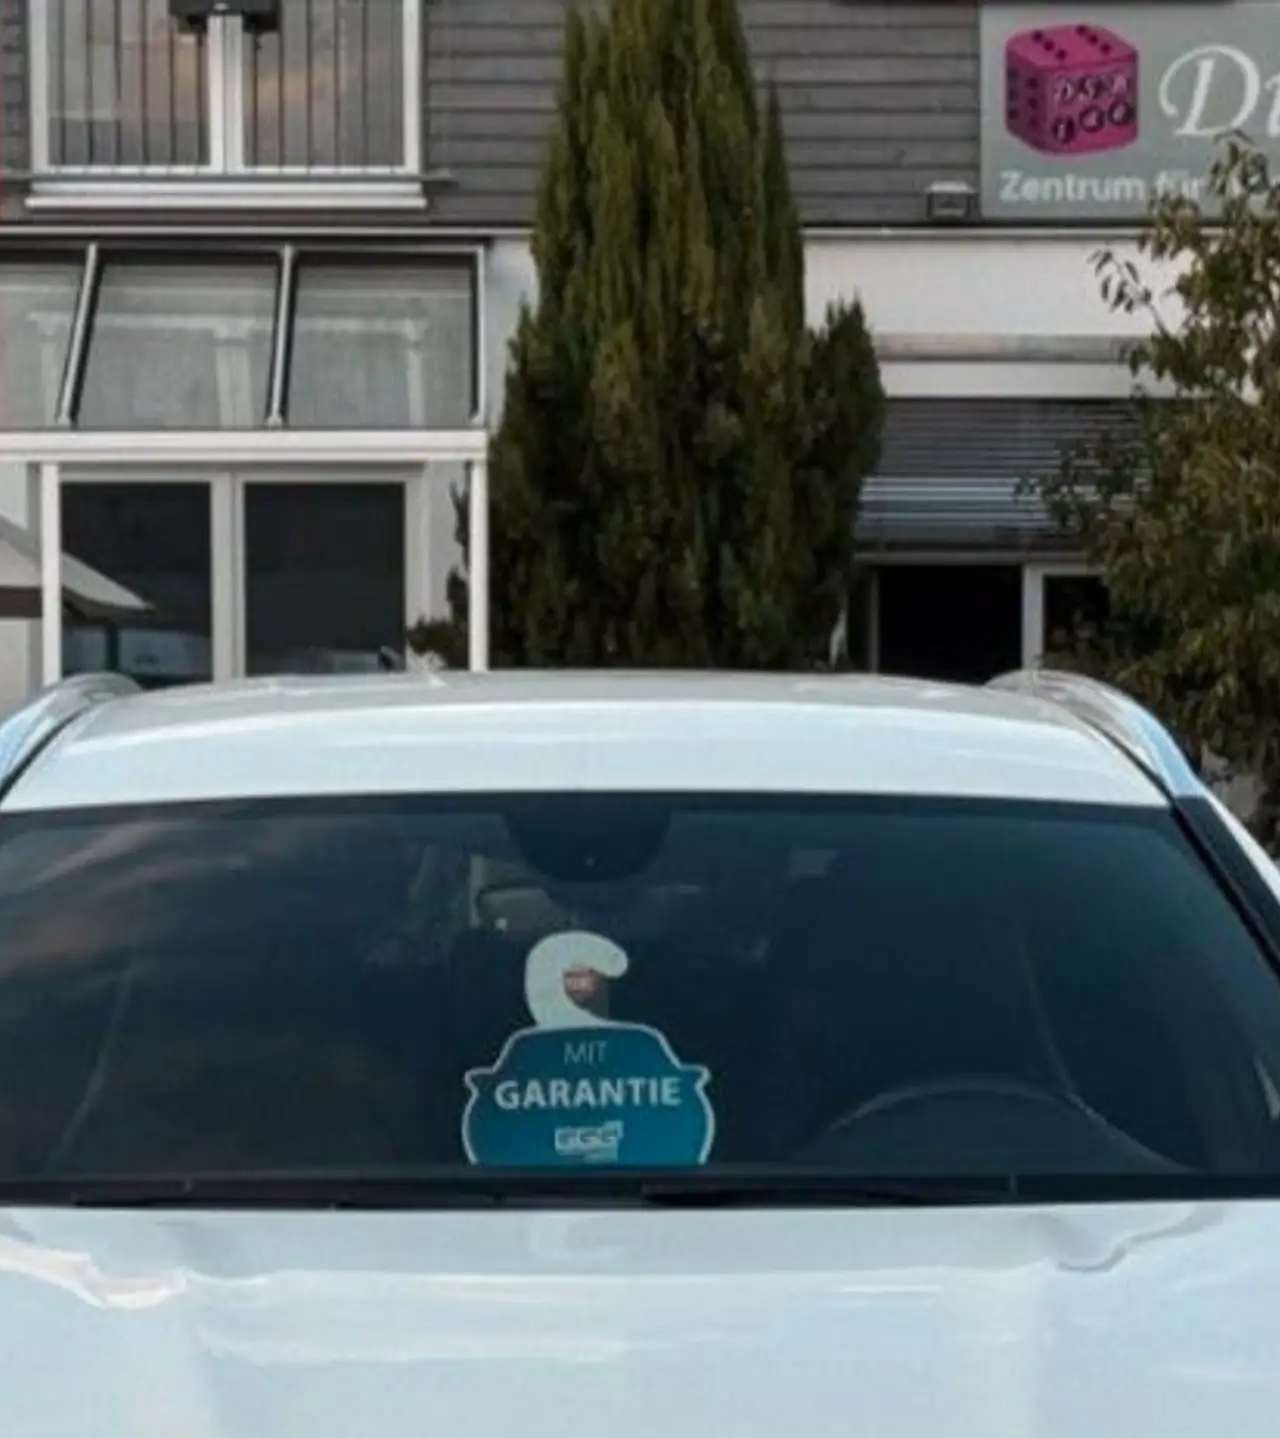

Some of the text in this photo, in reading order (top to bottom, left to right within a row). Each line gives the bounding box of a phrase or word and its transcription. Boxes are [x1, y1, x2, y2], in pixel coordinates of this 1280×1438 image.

[1000, 169, 1143, 202] Zentrum
[563, 1040, 608, 1064] MIT
[494, 1076, 683, 1110] GARANTIE
